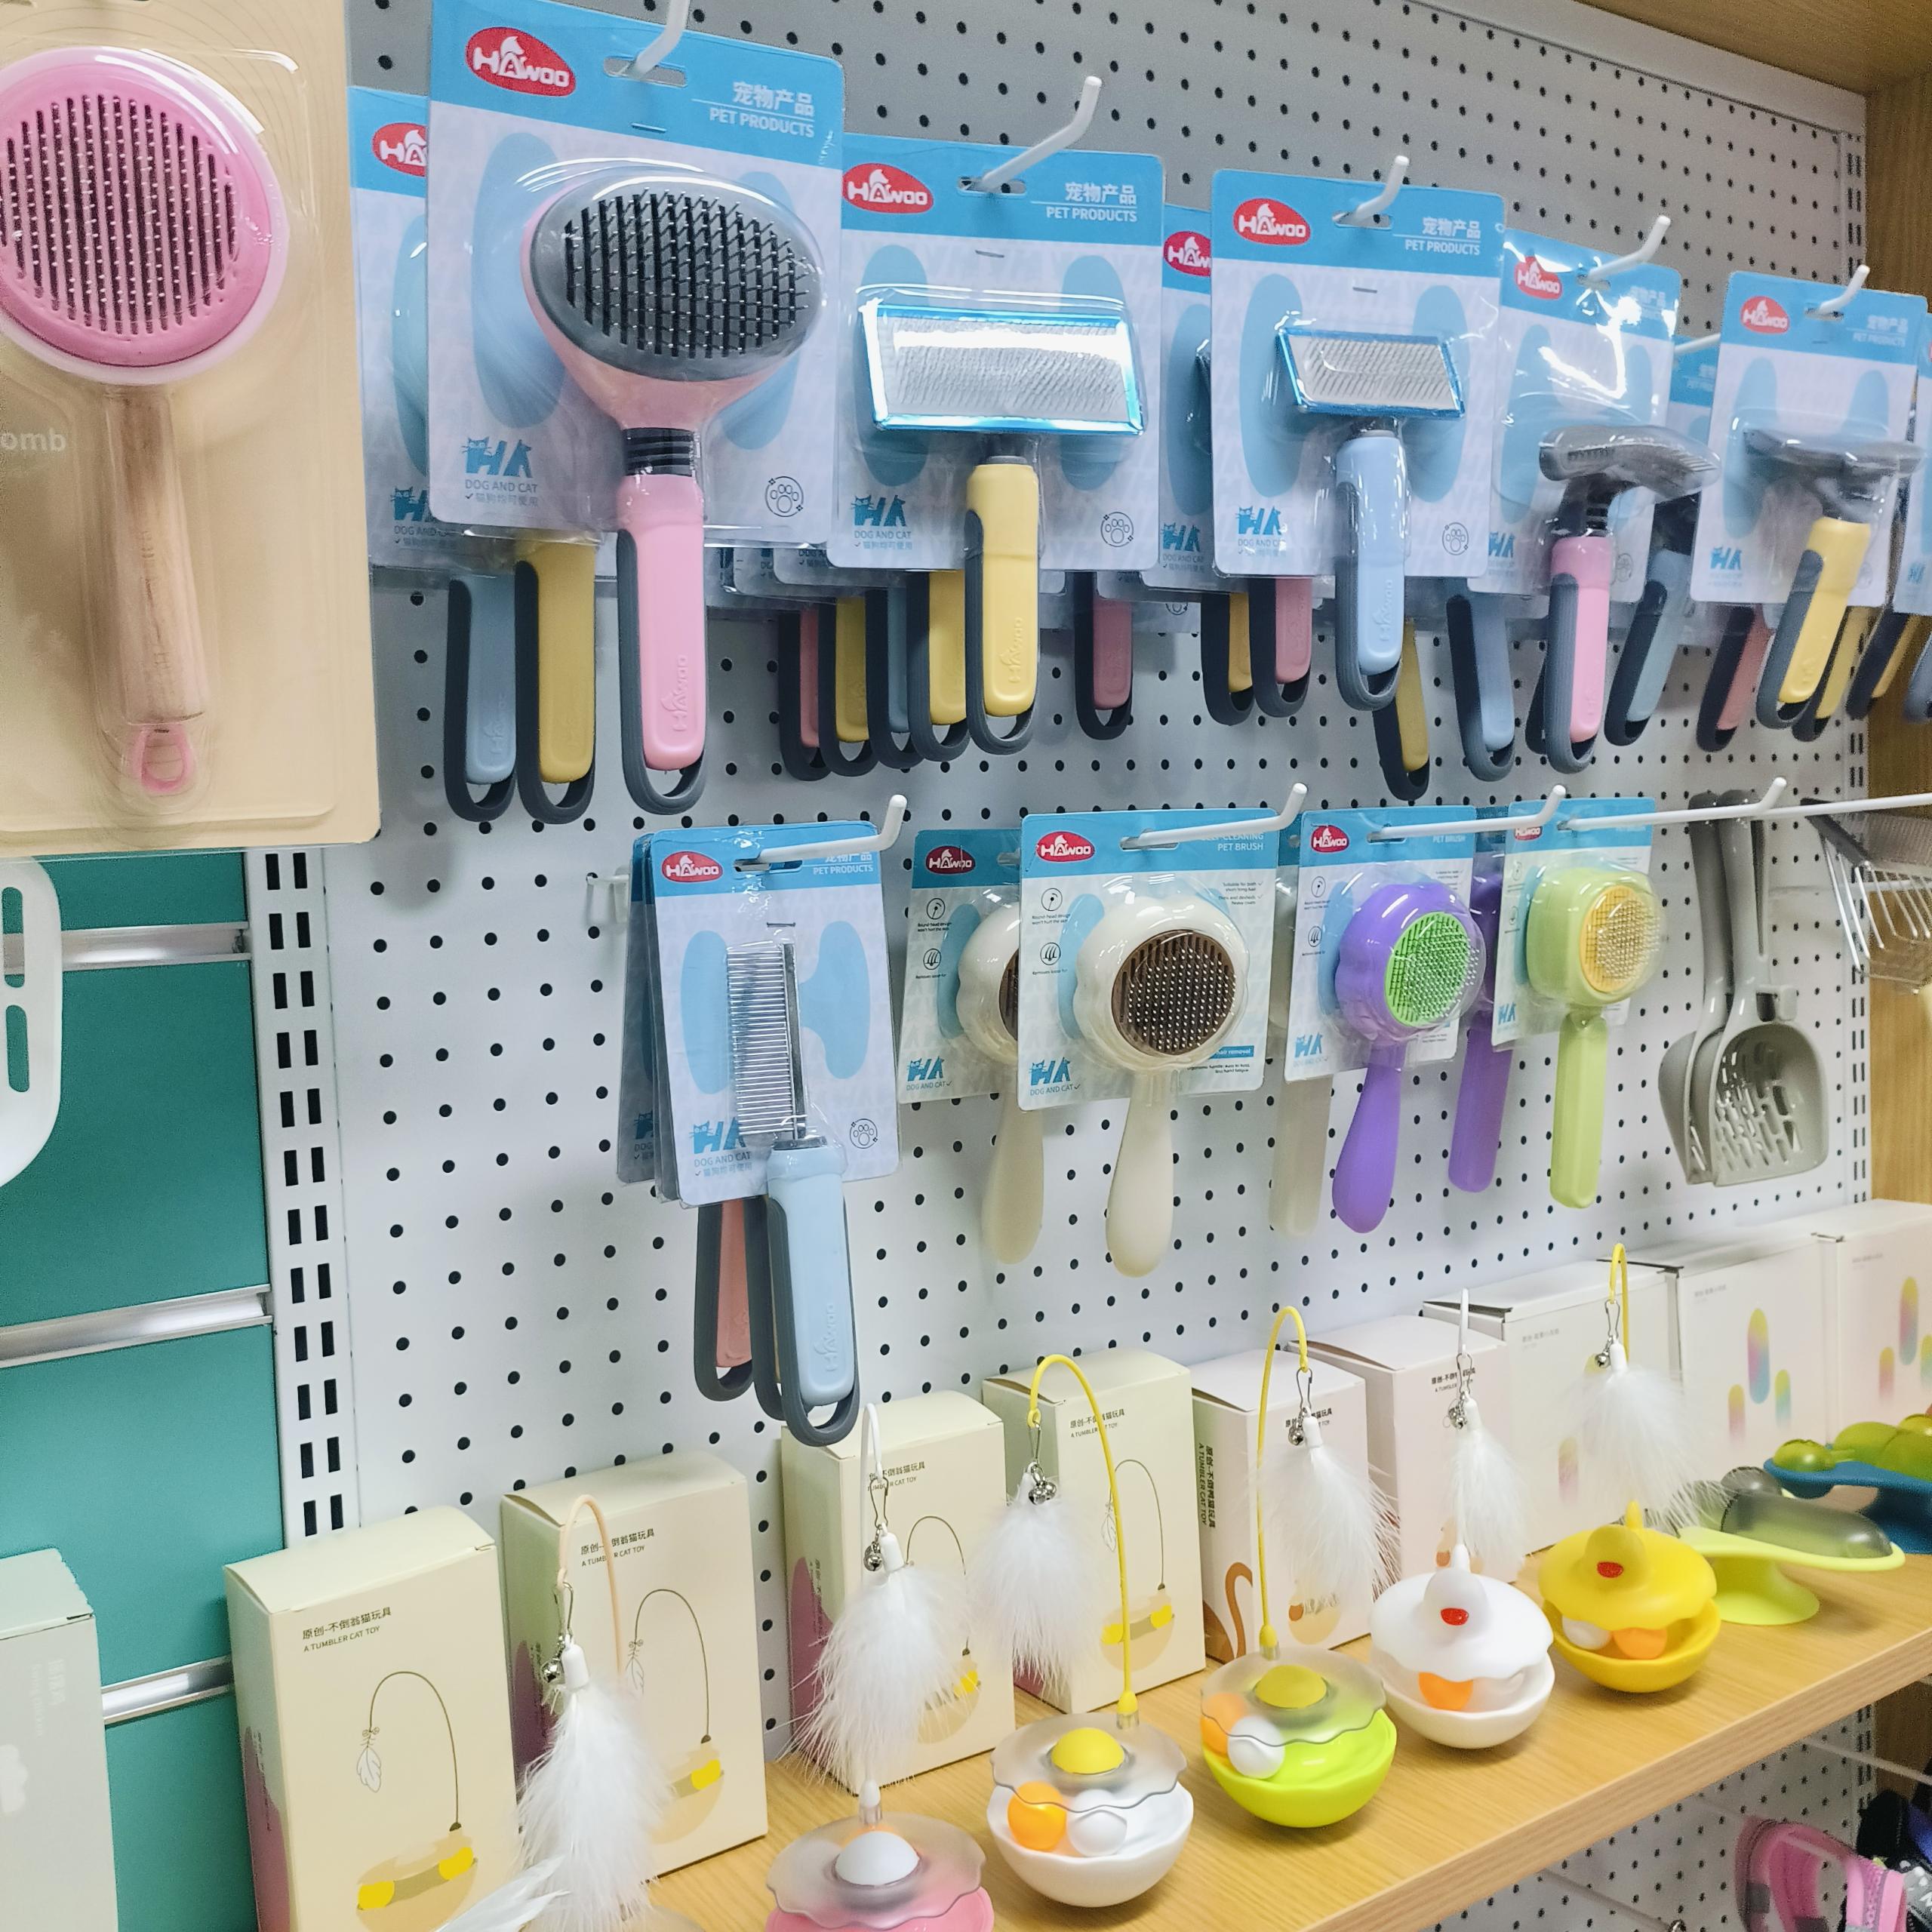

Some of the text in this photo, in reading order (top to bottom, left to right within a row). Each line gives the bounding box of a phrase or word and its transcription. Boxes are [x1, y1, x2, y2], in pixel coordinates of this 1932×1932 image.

[733, 81, 814, 117] 宠物产品
[709, 107, 814, 138] PET PRODUCTS
[1065, 181, 1137, 205] 宠物产品
[1046, 206, 1137, 222] PET PRODUCTS
[1423, 217, 1481, 239] 宠物产品
[1405, 239, 1481, 256] PET PRODUCTS
[465, 479, 538, 494] DOG AND CAT
[854, 530, 912, 540] DOG AND CAT
[1238, 538, 1254, 547] DOG
[1256, 539, 1271, 548] AND
[1217, 842, 1264, 851] PET BRUSH
[813, 864, 873, 875] PET PRODUCTS
[694, 1151, 752, 1168] DOG AND CAT
[620, 1548, 631, 1557] CAT
[632, 1545, 645, 1553] TOY
[303, 1607, 391, 1640] 原创-不倒翁猫玩具
[310, 1635, 348, 1651] TUMBLER
[349, 1629, 364, 1640] CAT
[365, 1626, 380, 1635] TOY
